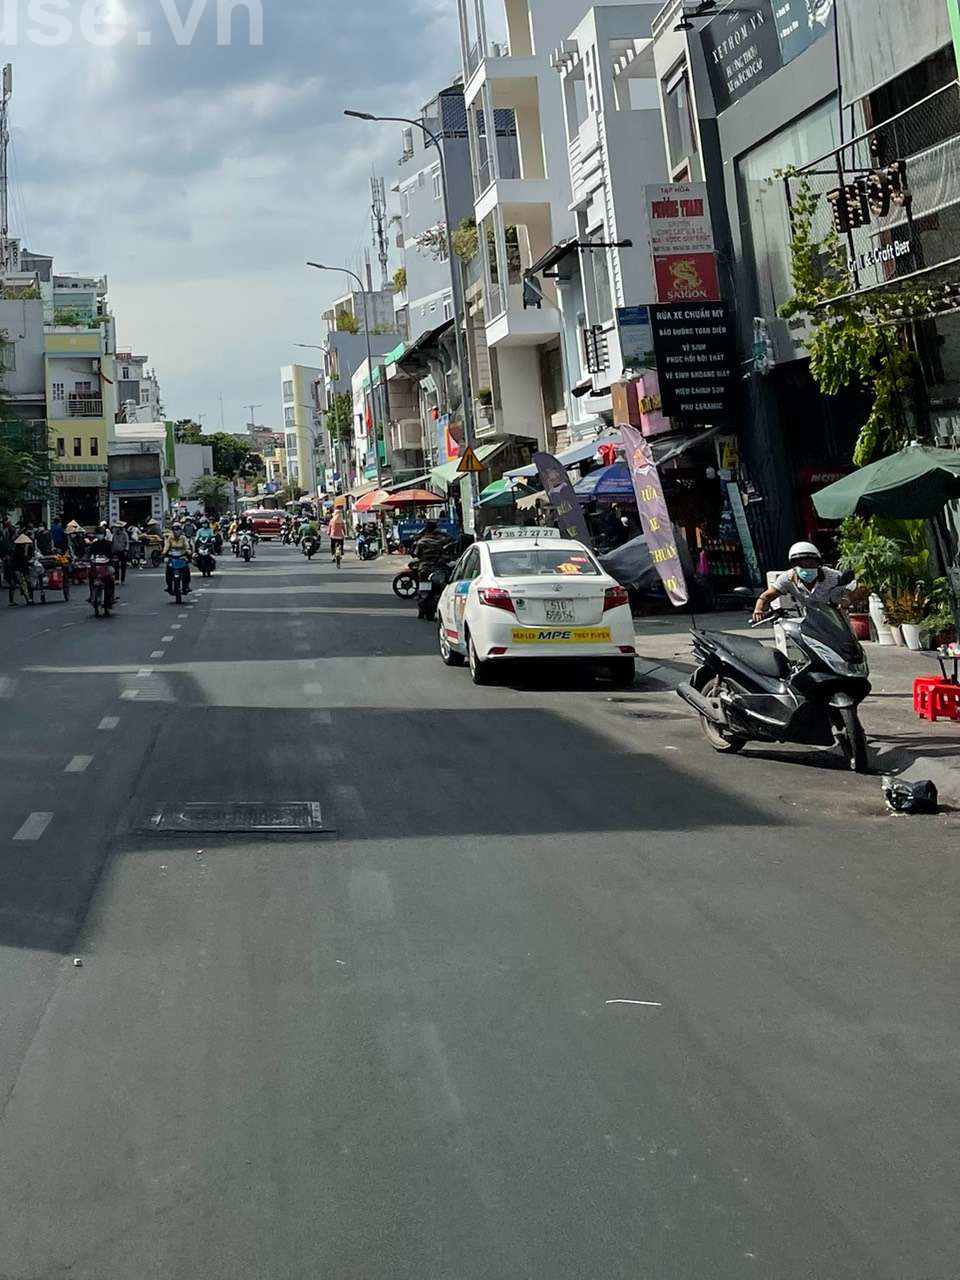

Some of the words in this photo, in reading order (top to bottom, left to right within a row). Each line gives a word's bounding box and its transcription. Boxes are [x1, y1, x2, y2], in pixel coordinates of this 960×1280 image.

[894, 240, 910, 257] Beer
[518, 529, 528, 537] 27
[530, 529, 540, 537] 27
[543, 529, 554, 537] 27
[537, 631, 573, 640] MPE
